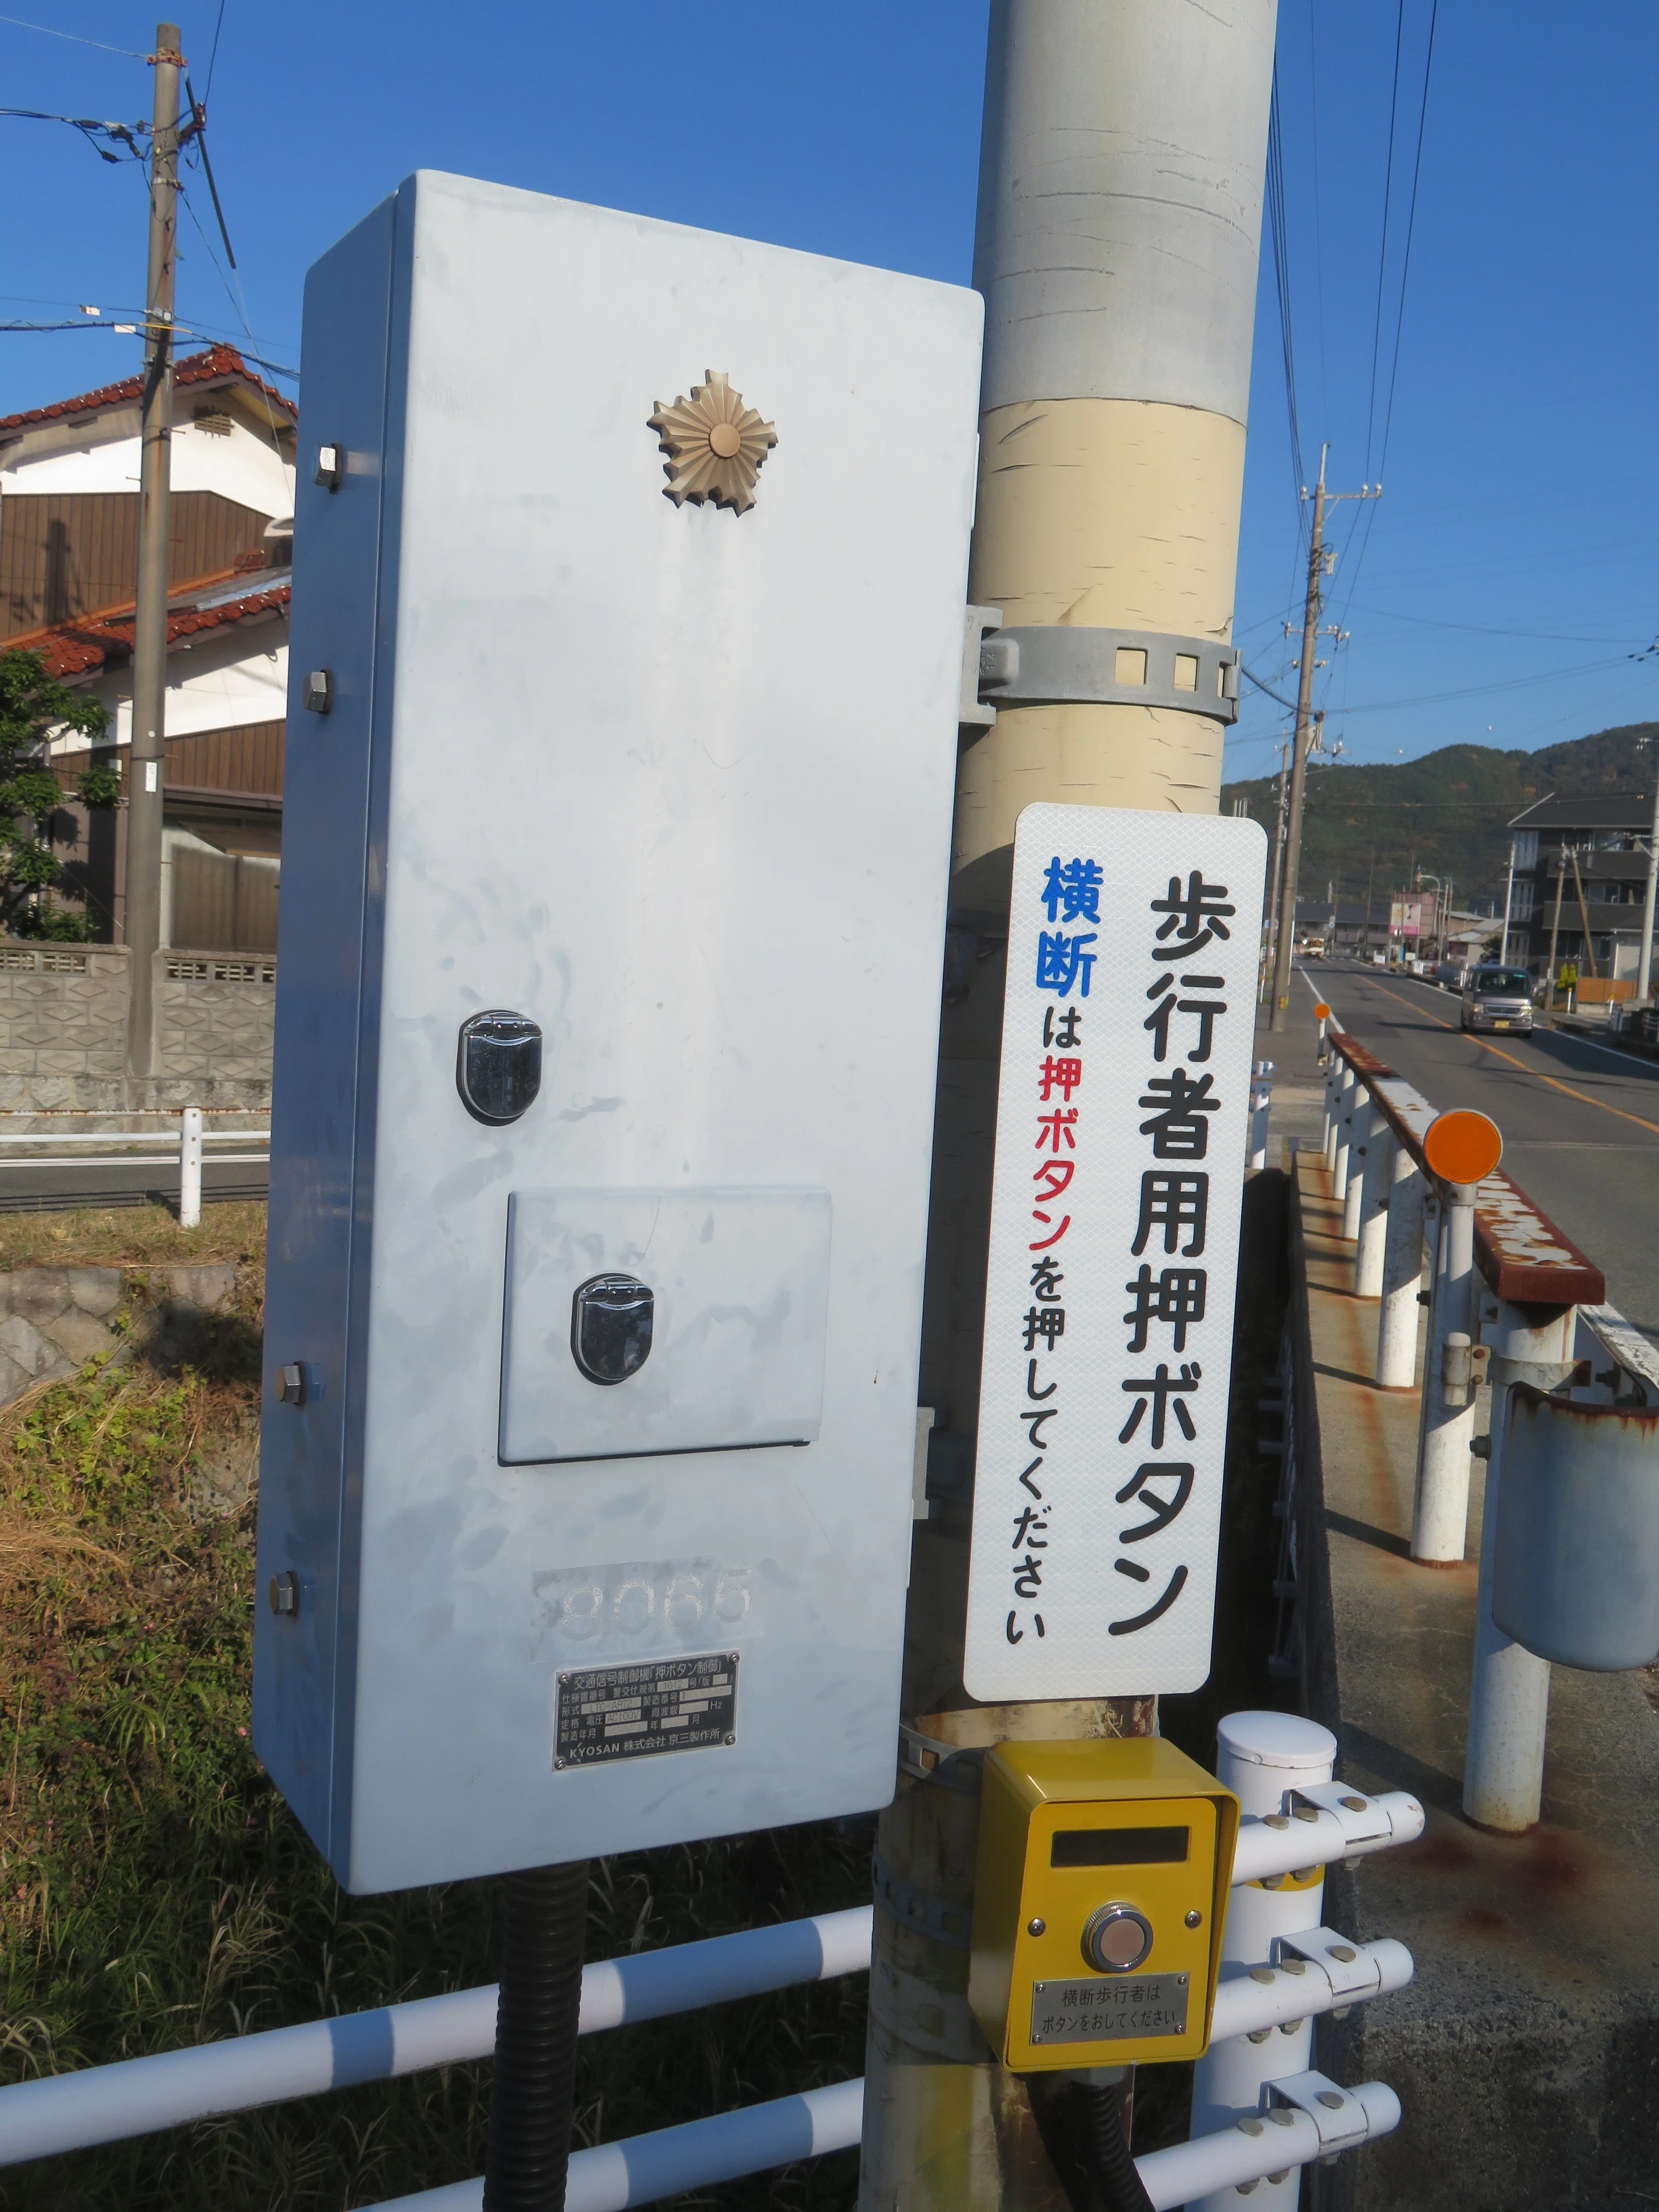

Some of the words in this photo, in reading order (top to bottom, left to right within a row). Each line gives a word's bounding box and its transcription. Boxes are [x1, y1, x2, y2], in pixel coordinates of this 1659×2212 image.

[1006, 856, 1104, 1645] 横断は押ボタンを押してください
[1108, 870, 1236, 1636] 歩行者用押ボタン
[561, 1718, 579, 1730] 定格
[586, 1714, 603, 1726] 電圧
[607, 1710, 639, 1723] AC100V
[651, 1705, 678, 1718] 周波数
[710, 1700, 723, 1710] Hz
[562, 1704, 579, 1717] 形式
[590, 1699, 632, 1713] LTC-AR72
[643, 1692, 678, 1706] 製造番号
[560, 1728, 596, 1743] 製造年月
[650, 1720, 658, 1730] 年
[691, 1714, 700, 1724] 月
[570, 1742, 620, 1758] KYOSAN
[623, 1735, 666, 1752] 株式会社
[668, 1727, 721, 1746] 京三製作所
[1062, 1984, 1161, 2007] 横断歩行者は
[1042, 2008, 1175, 2034] ボタンをおしてください
